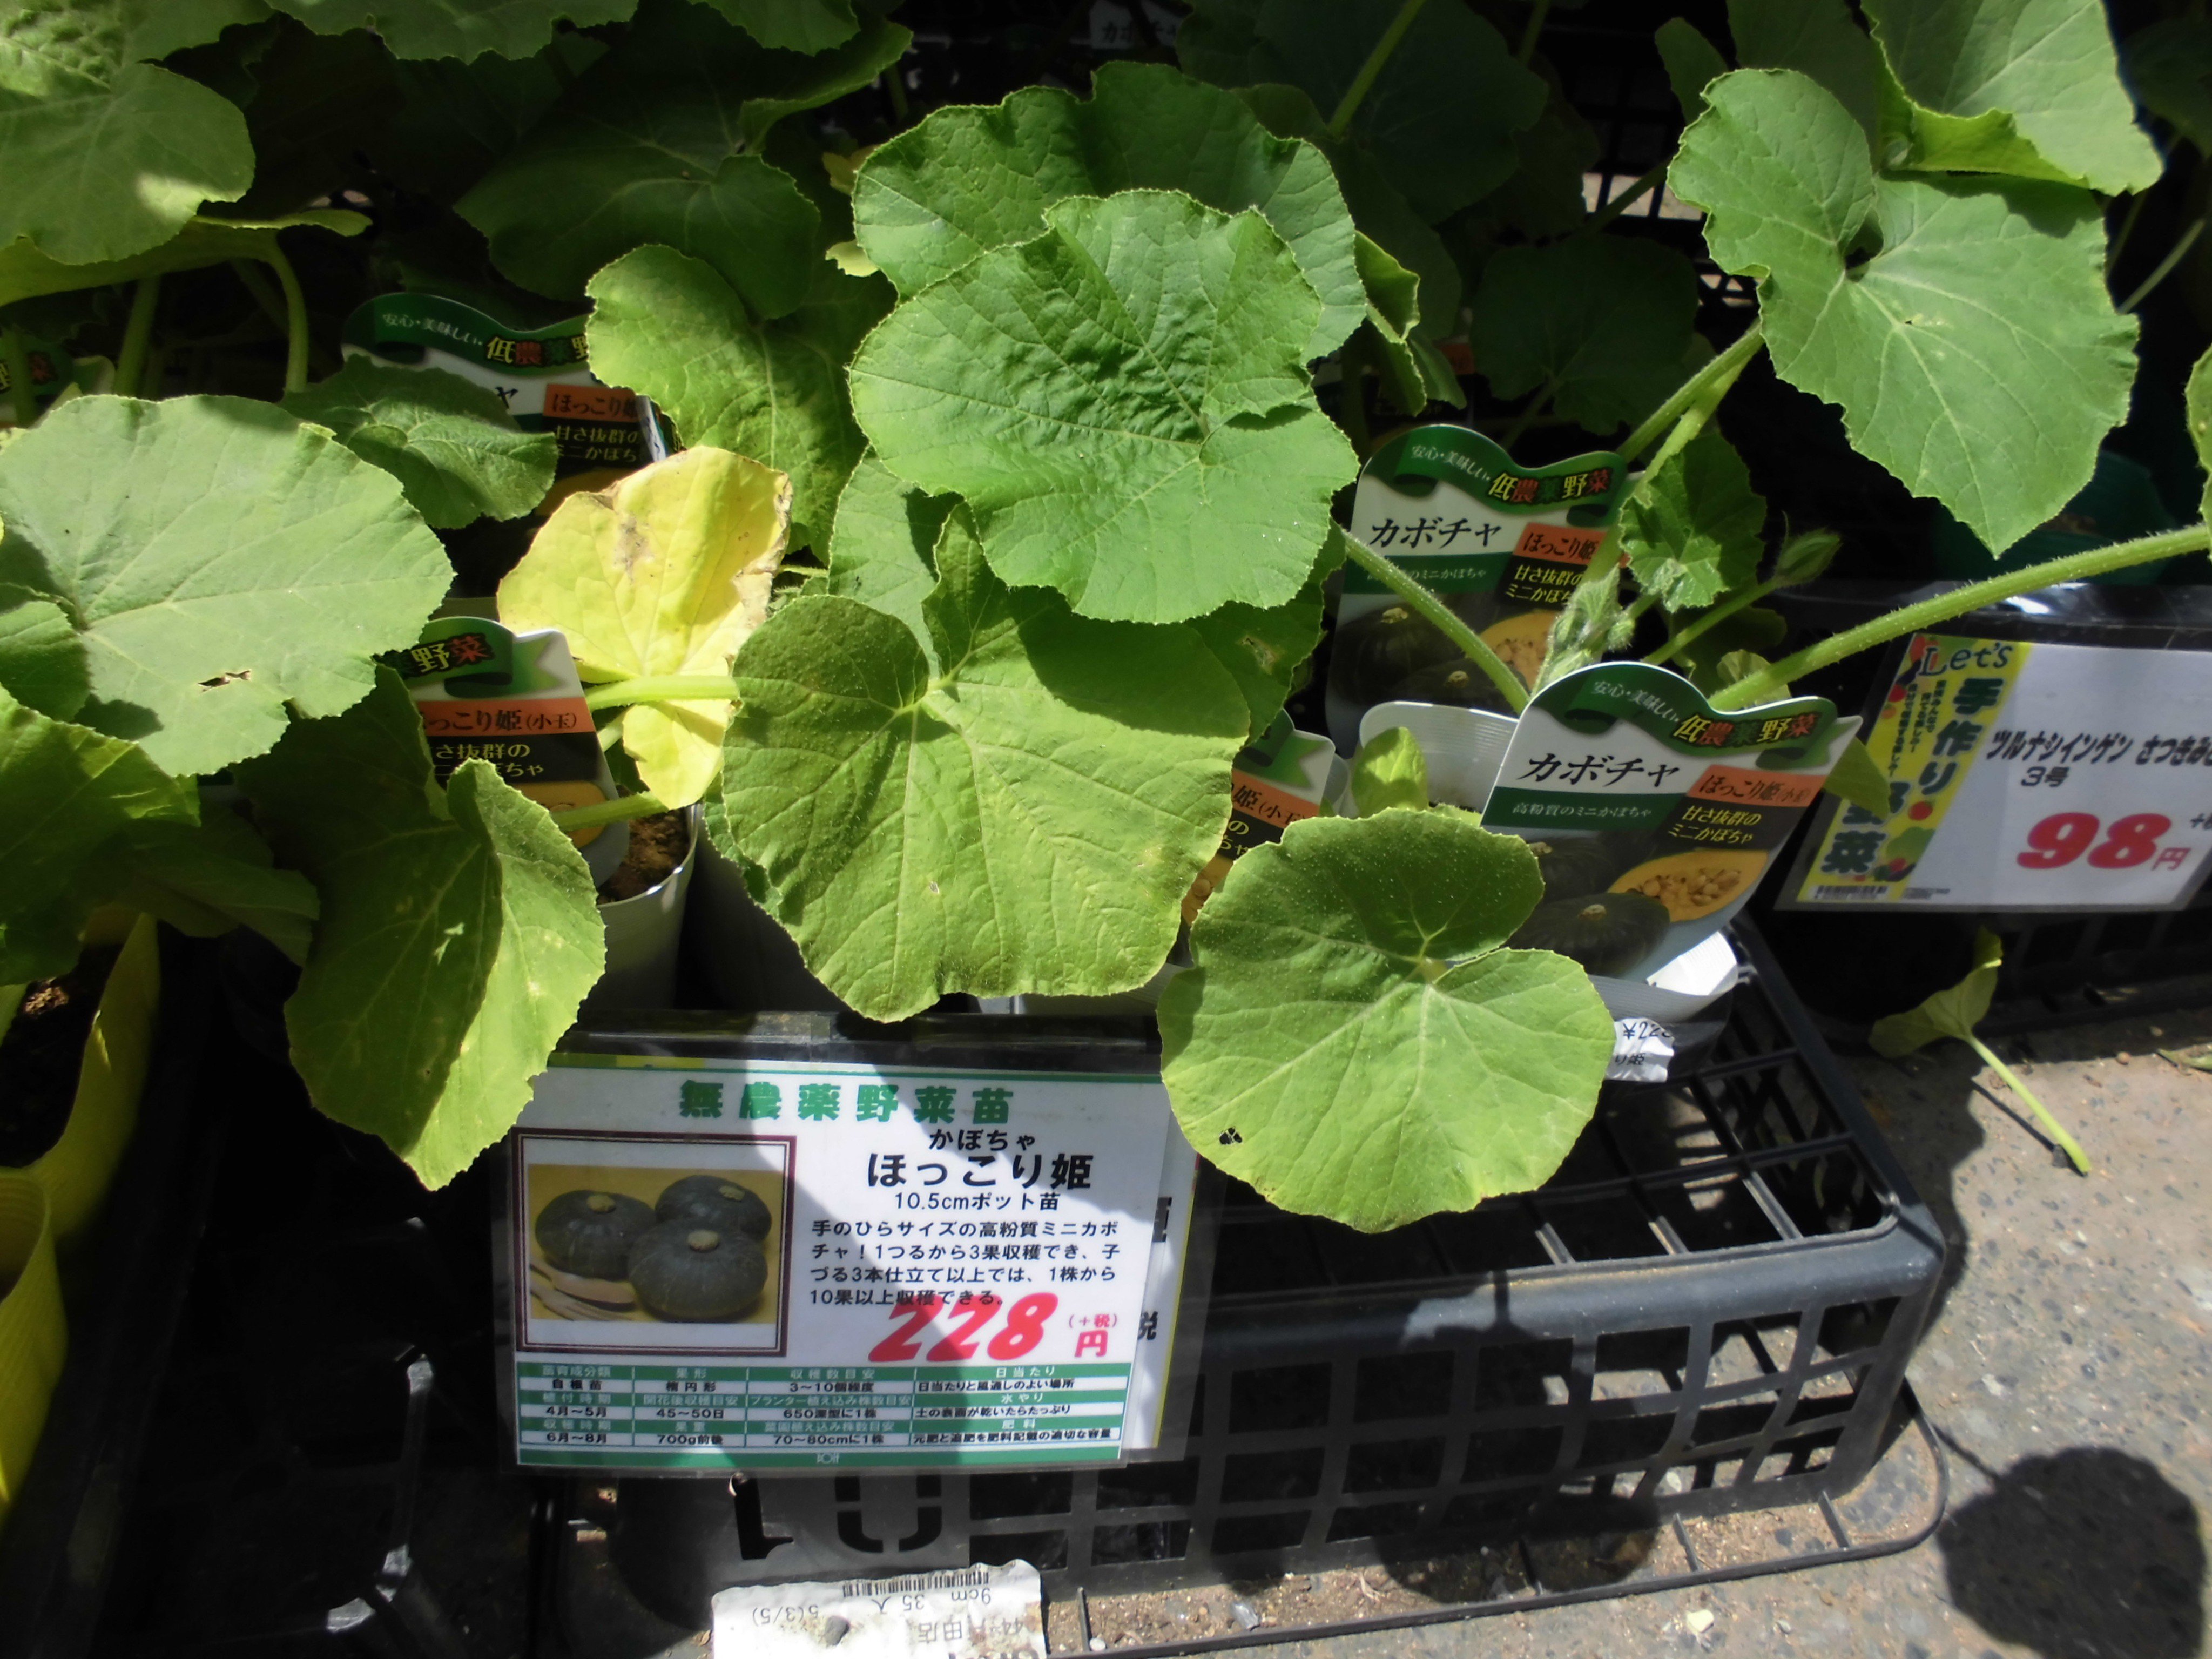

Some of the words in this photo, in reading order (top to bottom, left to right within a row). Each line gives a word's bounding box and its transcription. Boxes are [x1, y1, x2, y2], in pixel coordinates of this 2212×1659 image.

[1370, 517, 1502, 550] カボチャ
[1917, 642, 2014, 676] Let's
[1672, 712, 1818, 747] 低農薬野菜
[1918, 678, 2004, 795] 手作り
[1986, 730, 2134, 765] ツルナシインゲン
[1517, 753, 1680, 788] カボチャ
[2020, 766, 2070, 787] 3号
[1512, 802, 1653, 818] 高粉質のミニかぼちゃ
[1682, 805, 1763, 826] 甘さ抜群の
[1668, 823, 1754, 845] ミニかぼちゃ
[2016, 812, 2172, 870] 98
[2151, 847, 2192, 871] 円
[680, 1080, 1014, 1125] 無農薬野菜苗
[929, 1128, 1036, 1151] かぼちゃ
[867, 1152, 1095, 1190] ほっこり姫
[895, 1192, 1061, 1211] 10.5cmポット苗
[811, 1220, 1118, 1238] 手のひらサイズの高粉質ミニカボ
[812, 1243, 1121, 1261] チャ!1つるから3果収穫でき、子
[810, 1266, 1116, 1284] づる3本仕立て以上では、1株から
[810, 1289, 1003, 1306] 10果以上収穫できる。
[867, 1292, 1059, 1363] 228
[1074, 1330, 1109, 1358] 円
[995, 1366, 1056, 1379] 日当たり
[1001, 1391, 1043, 1404] 水やり
[902, 1594, 926, 1611] 35
[951, 1587, 992, 1605] 9cm
